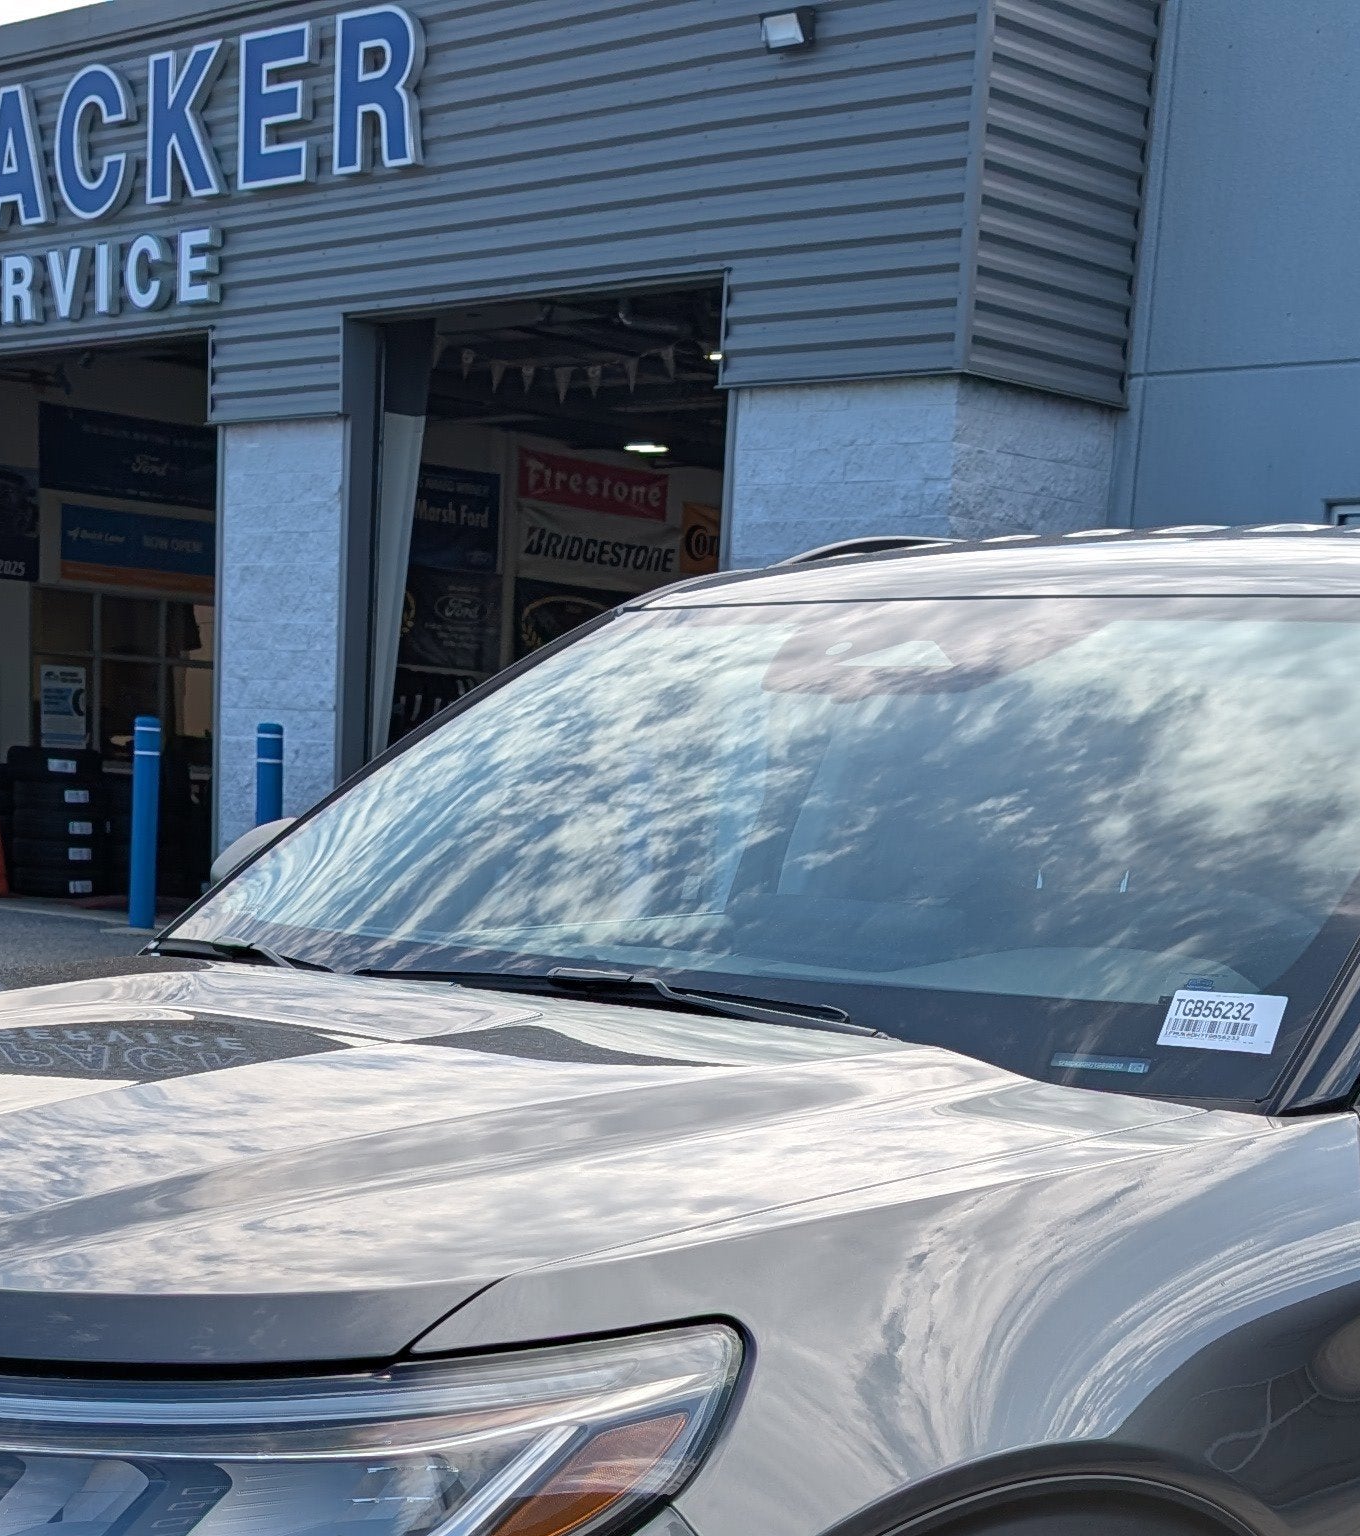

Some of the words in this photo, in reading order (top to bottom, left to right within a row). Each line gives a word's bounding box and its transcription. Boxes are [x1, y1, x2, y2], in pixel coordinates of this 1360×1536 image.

[525, 457, 664, 509] Firestone
[460, 503, 490, 528] Ford
[524, 526, 676, 574] BRIDGESTONE
[1175, 998, 1255, 1022] TGB56232
